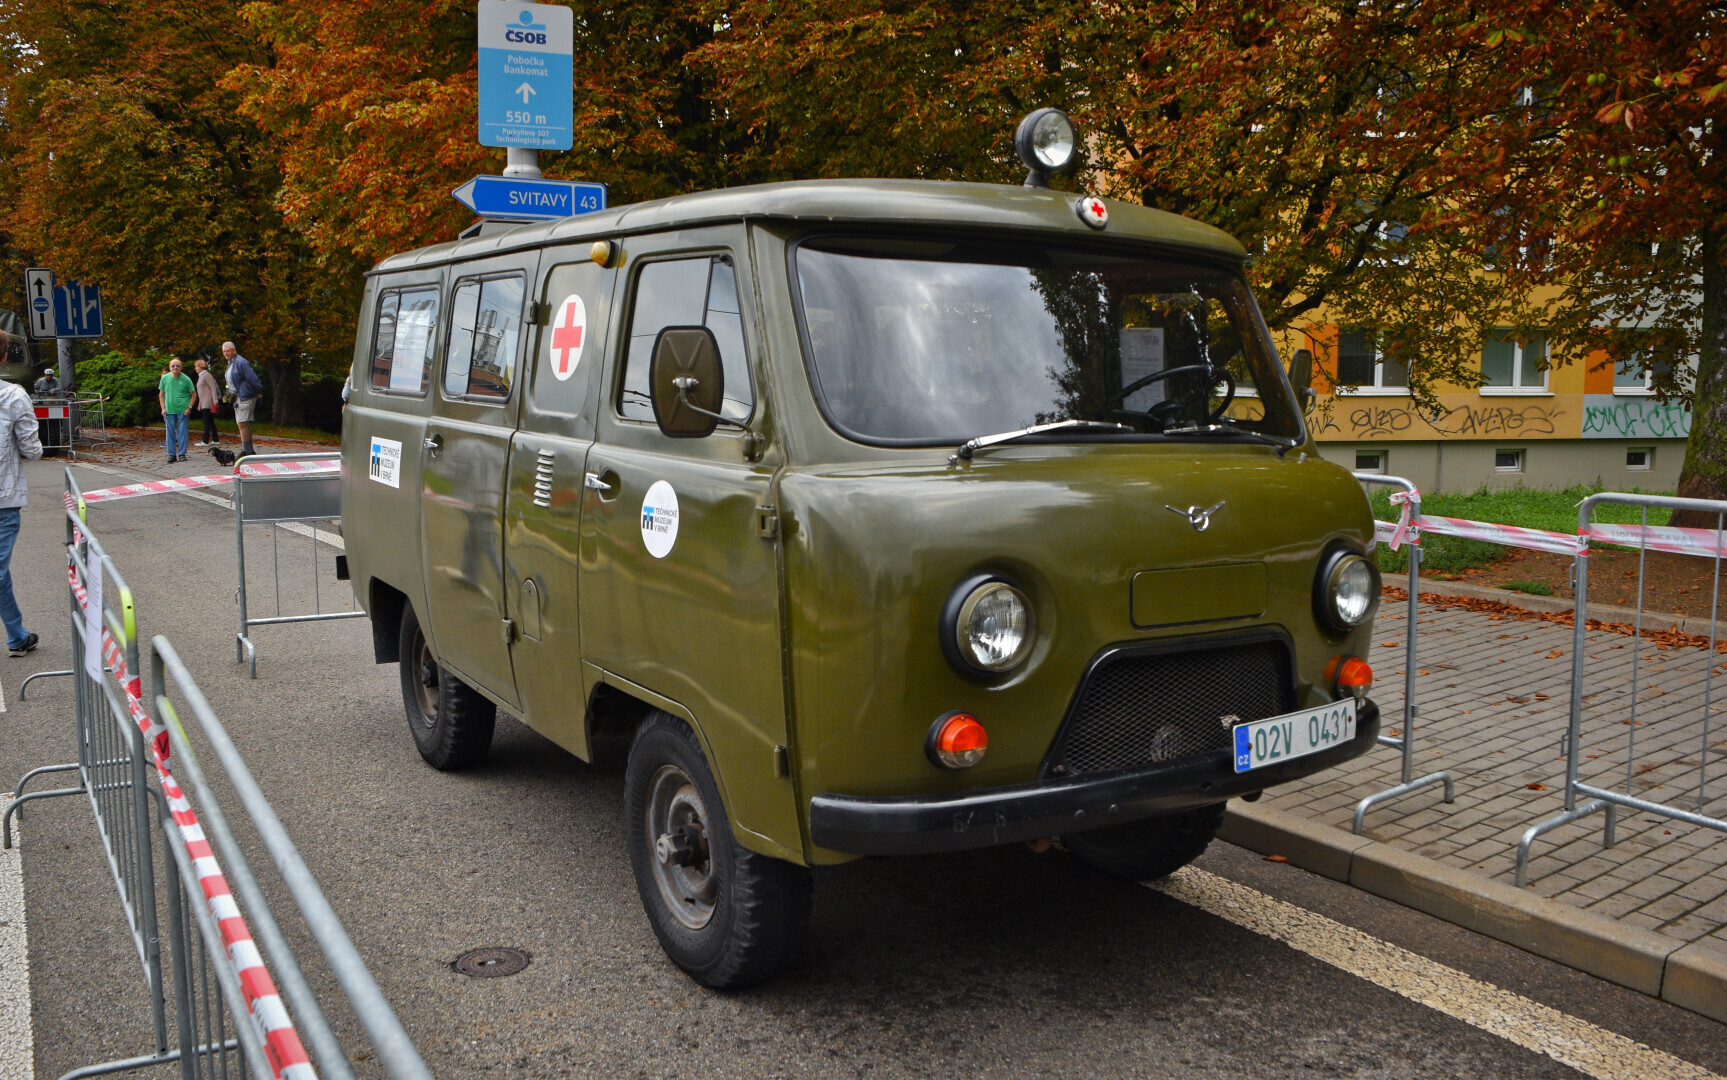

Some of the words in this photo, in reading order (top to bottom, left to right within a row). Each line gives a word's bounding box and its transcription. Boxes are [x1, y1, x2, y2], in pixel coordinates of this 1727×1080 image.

[505, 29, 547, 45] ČSOB
[507, 54, 545, 66] Pobočka
[503, 64, 549, 77] Bankomat
[506, 110, 531, 124] 550
[535, 114, 547, 124] m
[495, 135, 541, 145] Technologický
[541, 138, 557, 146] park
[509, 190, 568, 208] SVITAVY
[580, 195, 598, 210] 43
[1255, 721, 1293, 761] 02V
[1309, 706, 1348, 747] 0431
[1238, 754, 1249, 766] CZ
